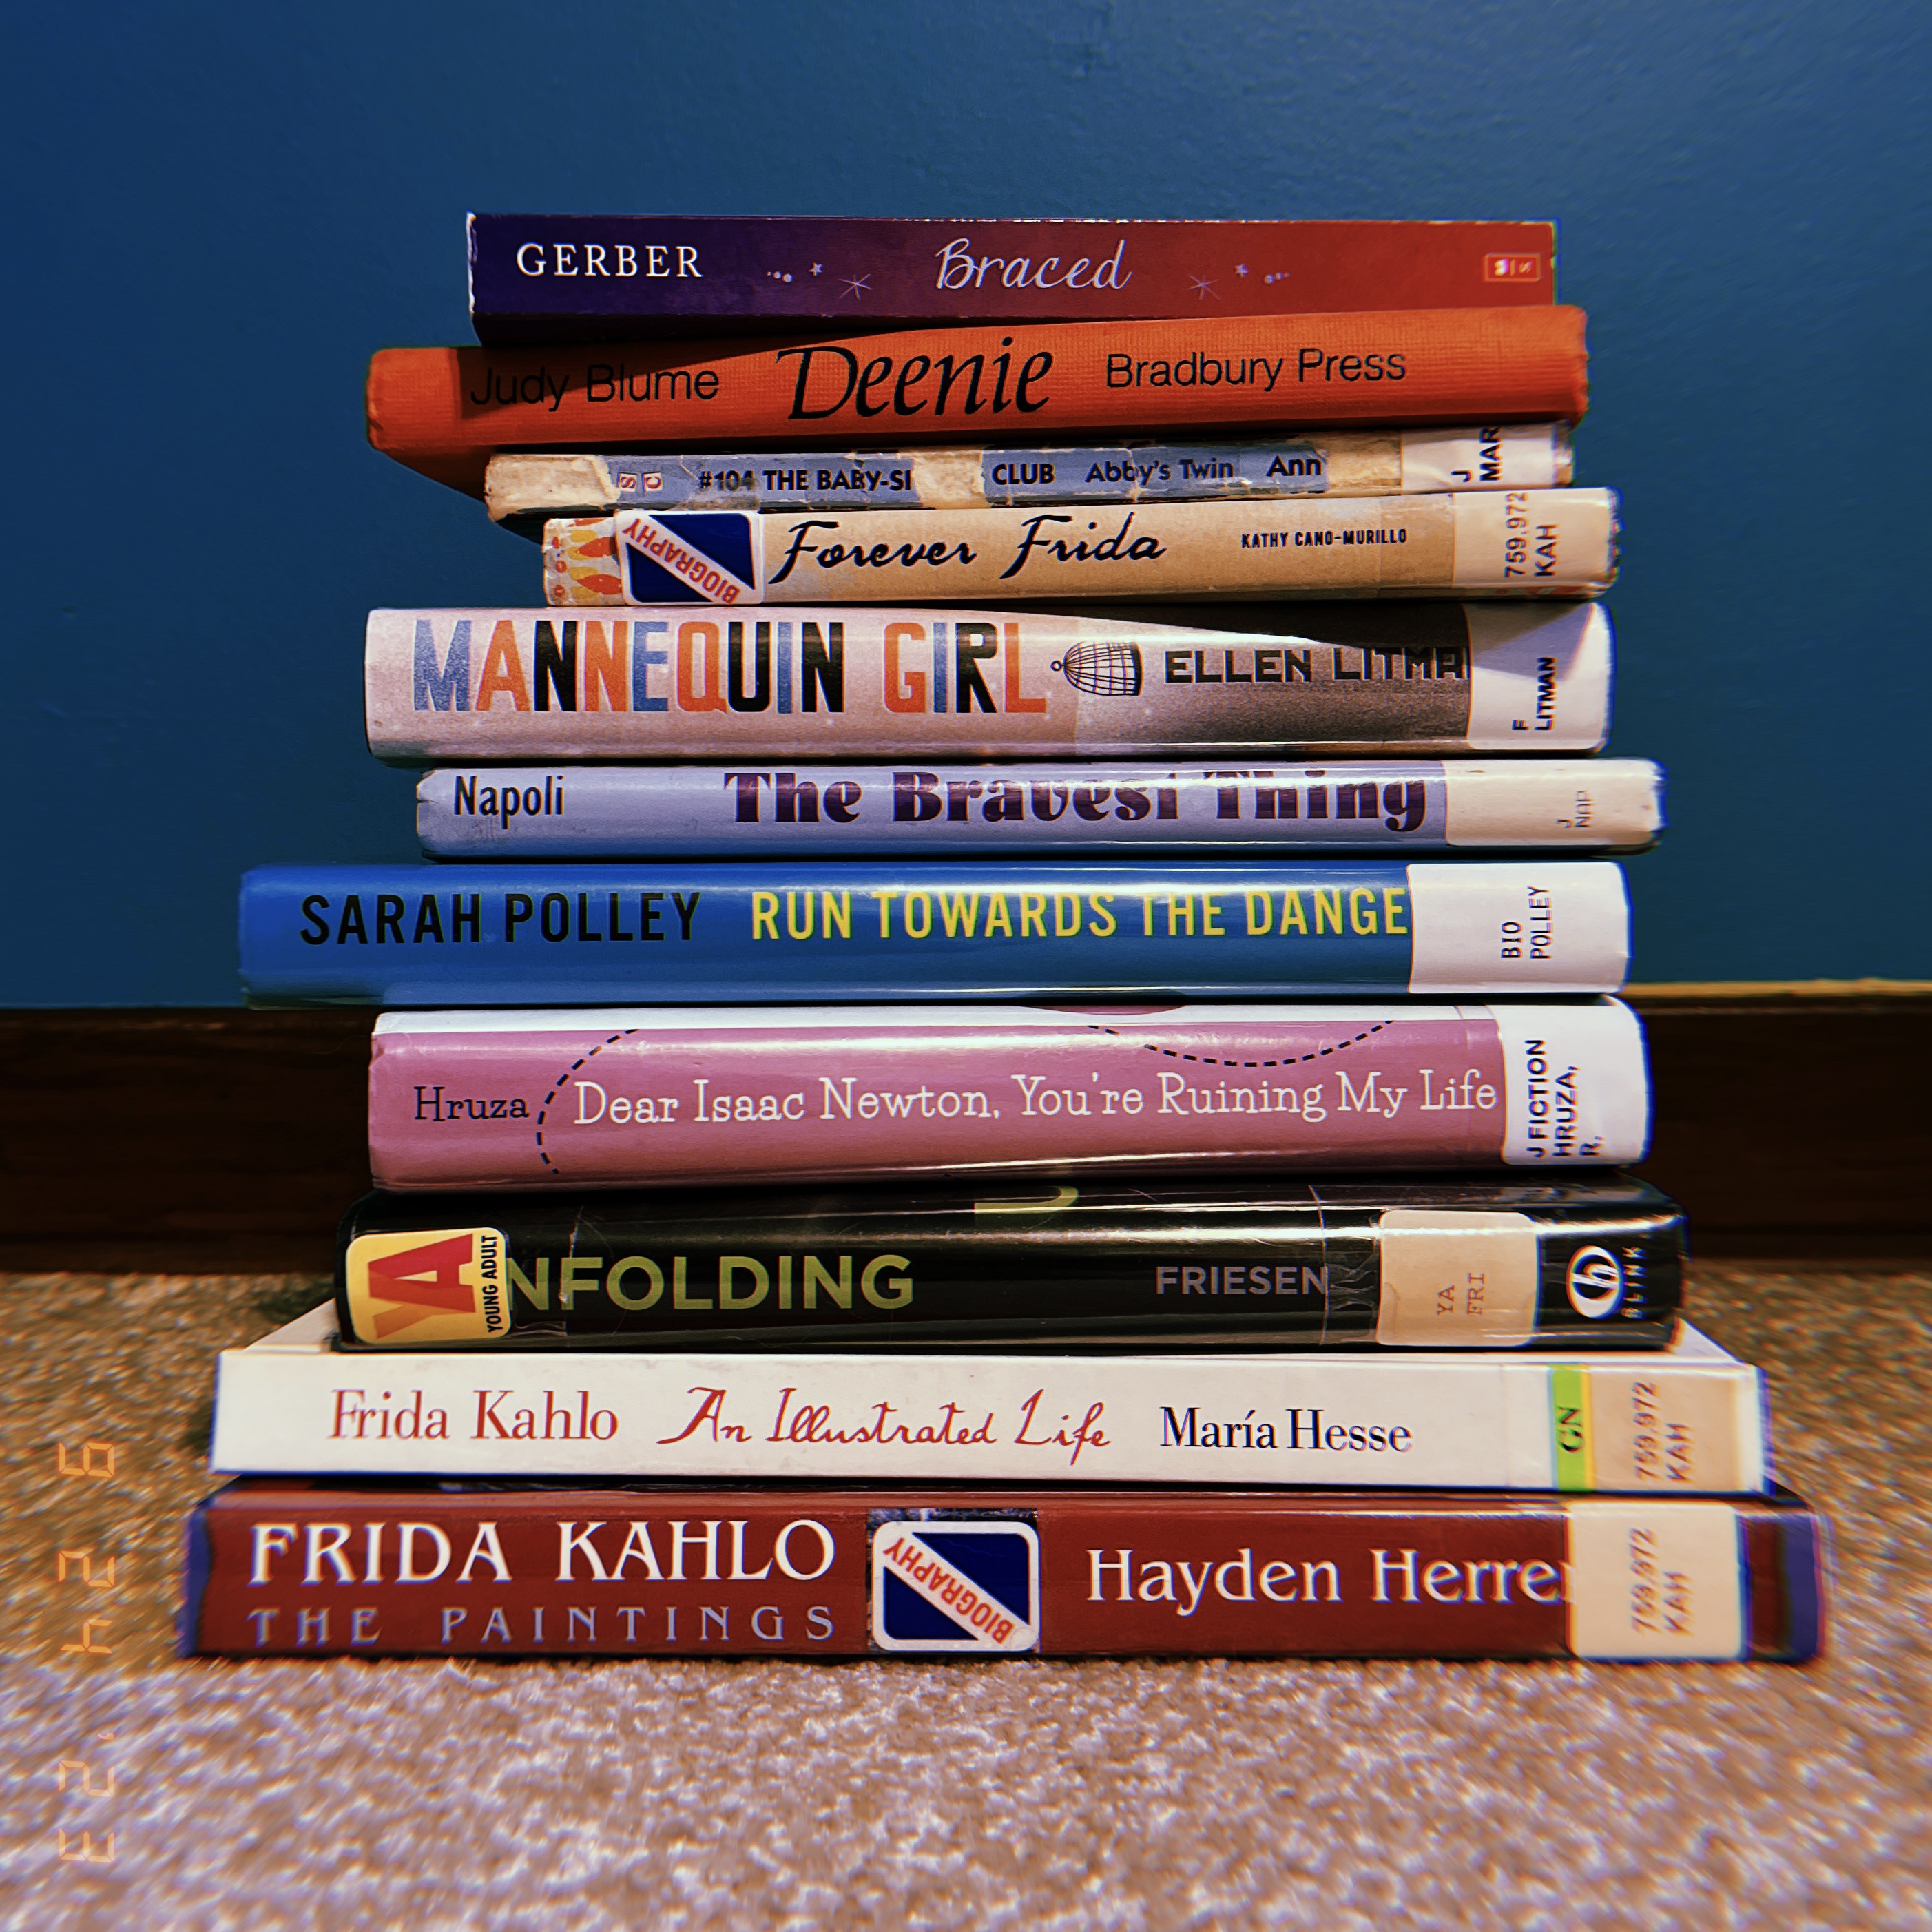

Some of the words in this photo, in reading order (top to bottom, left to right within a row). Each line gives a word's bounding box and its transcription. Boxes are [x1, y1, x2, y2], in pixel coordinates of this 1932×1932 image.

[517, 243, 703, 277] GERBER
[934, 238, 1132, 290] Braced
[471, 366, 569, 412] Judy
[588, 363, 719, 403] Blume
[775, 337, 1054, 419] Deenie
[1107, 353, 1282, 392] Bradbury
[1298, 348, 1406, 382] Press
[698, 470, 755, 491] #104
[762, 470, 809, 491] THE
[992, 463, 1055, 484] CLUB
[1085, 459, 1171, 486] Abby's
[1178, 457, 1234, 480] Twin
[1266, 455, 1322, 477] Ann
[1451, 470, 1474, 482] J
[1479, 426, 1503, 481] MAR
[622, 517, 741, 605] BIOGRAPHY
[768, 520, 977, 584] Forever
[999, 512, 1166, 581] Frida
[1241, 532, 1288, 548] KATHY
[1294, 528, 1407, 546] CANO-MURILLO
[1504, 492, 1529, 578] 759.972
[1534, 523, 1560, 577] KAH
[413, 619, 845, 714] MANNEQUIN
[884, 621, 1047, 714] GIRL
[1165, 649, 1311, 683] ELLEN
[1535, 657, 1558, 731] LITMAN
[1512, 719, 1530, 731] F
[454, 776, 565, 830] Napoli
[725, 771, 862, 823] The
[892, 771, 1179, 822] Bravest
[1203, 770, 1426, 832] Thing
[301, 894, 480, 945] SARAH
[506, 892, 700, 944] POLLEY
[751, 891, 851, 940] RUN
[872, 891, 1116, 939] TOWARDS
[1143, 893, 1225, 937] THE
[1246, 888, 1408, 935] DANGE
[1501, 920, 1524, 959] BIO
[1528, 885, 1553, 959] POLLEY
[414, 1086, 530, 1121] Hruza
[574, 1081, 679, 1125] Dear
[693, 1079, 804, 1123] Isaac
[819, 1076, 1001, 1121] Newton,
[1010, 1071, 1143, 1116] You're
[1156, 1072, 1327, 1123] Ruining
[1336, 1071, 1407, 1119] My
[1419, 1068, 1498, 1111] Life
[1525, 1039, 1550, 1137] FICTION
[1552, 1066, 1581, 1157] HRUZA,
[1526, 1146, 1548, 1158] J
[481, 1235, 499, 1280] ADULT
[1156, 1266, 1329, 1294] FRIESEN
[1621, 1247, 1648, 1319] BLINK
[482, 1285, 503, 1333] YOUNG
[1437, 1285, 1455, 1316] YA
[1466, 1272, 1487, 1316] FRI
[327, 1389, 450, 1440] Frida
[470, 1389, 619, 1440] Kahlo
[656, 1386, 753, 1444] An
[765, 1386, 997, 1445] Illustrated
[1013, 1388, 1110, 1466] Life
[1160, 1406, 1277, 1449] María
[1286, 1409, 1413, 1452] Hesse
[1665, 1423, 1697, 1486] KAH
[247, 1521, 512, 1586] FRIDA
[555, 1519, 835, 1581] KAHLO
[883, 1537, 1014, 1645] BIOGRAPHY
[1087, 1548, 1343, 1617] Hayden
[1663, 1570, 1695, 1637] KAH
[247, 1606, 382, 1648] THE
[442, 1606, 834, 1644] PAINTINGS
